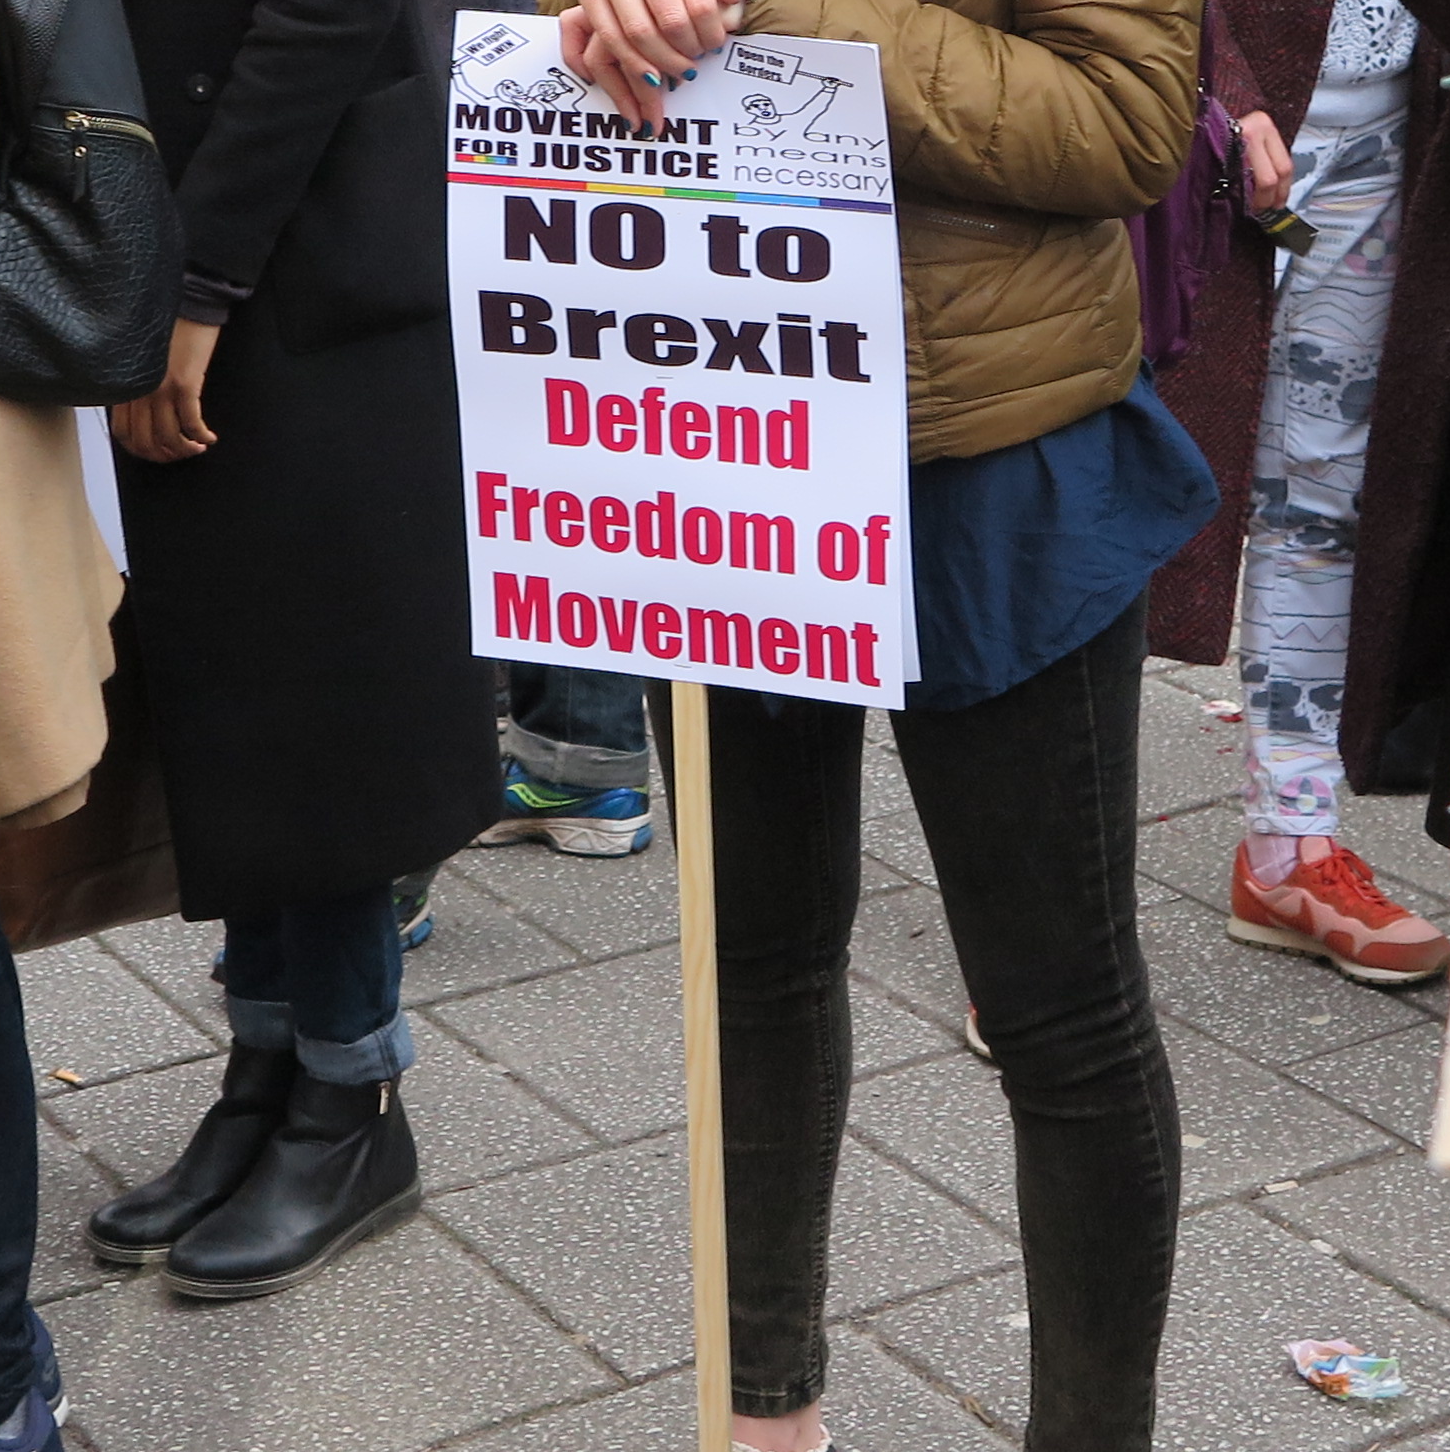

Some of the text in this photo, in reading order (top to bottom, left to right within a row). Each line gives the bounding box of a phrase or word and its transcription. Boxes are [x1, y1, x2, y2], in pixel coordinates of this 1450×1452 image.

[467, 27, 509, 55] We fight
[481, 39, 516, 62] to WIN
[737, 47, 785, 68] Open the
[738, 61, 782, 83] Borders
[734, 123, 886, 150] by any
[455, 137, 719, 180] FOR JUSTICE
[735, 145, 888, 168] means
[734, 164, 890, 197] necessary
[503, 195, 831, 283] NO to
[478, 290, 871, 384] Brexit
[544, 376, 811, 470] Defend
[475, 470, 892, 585] Freedom of
[493, 571, 881, 688] Movement
